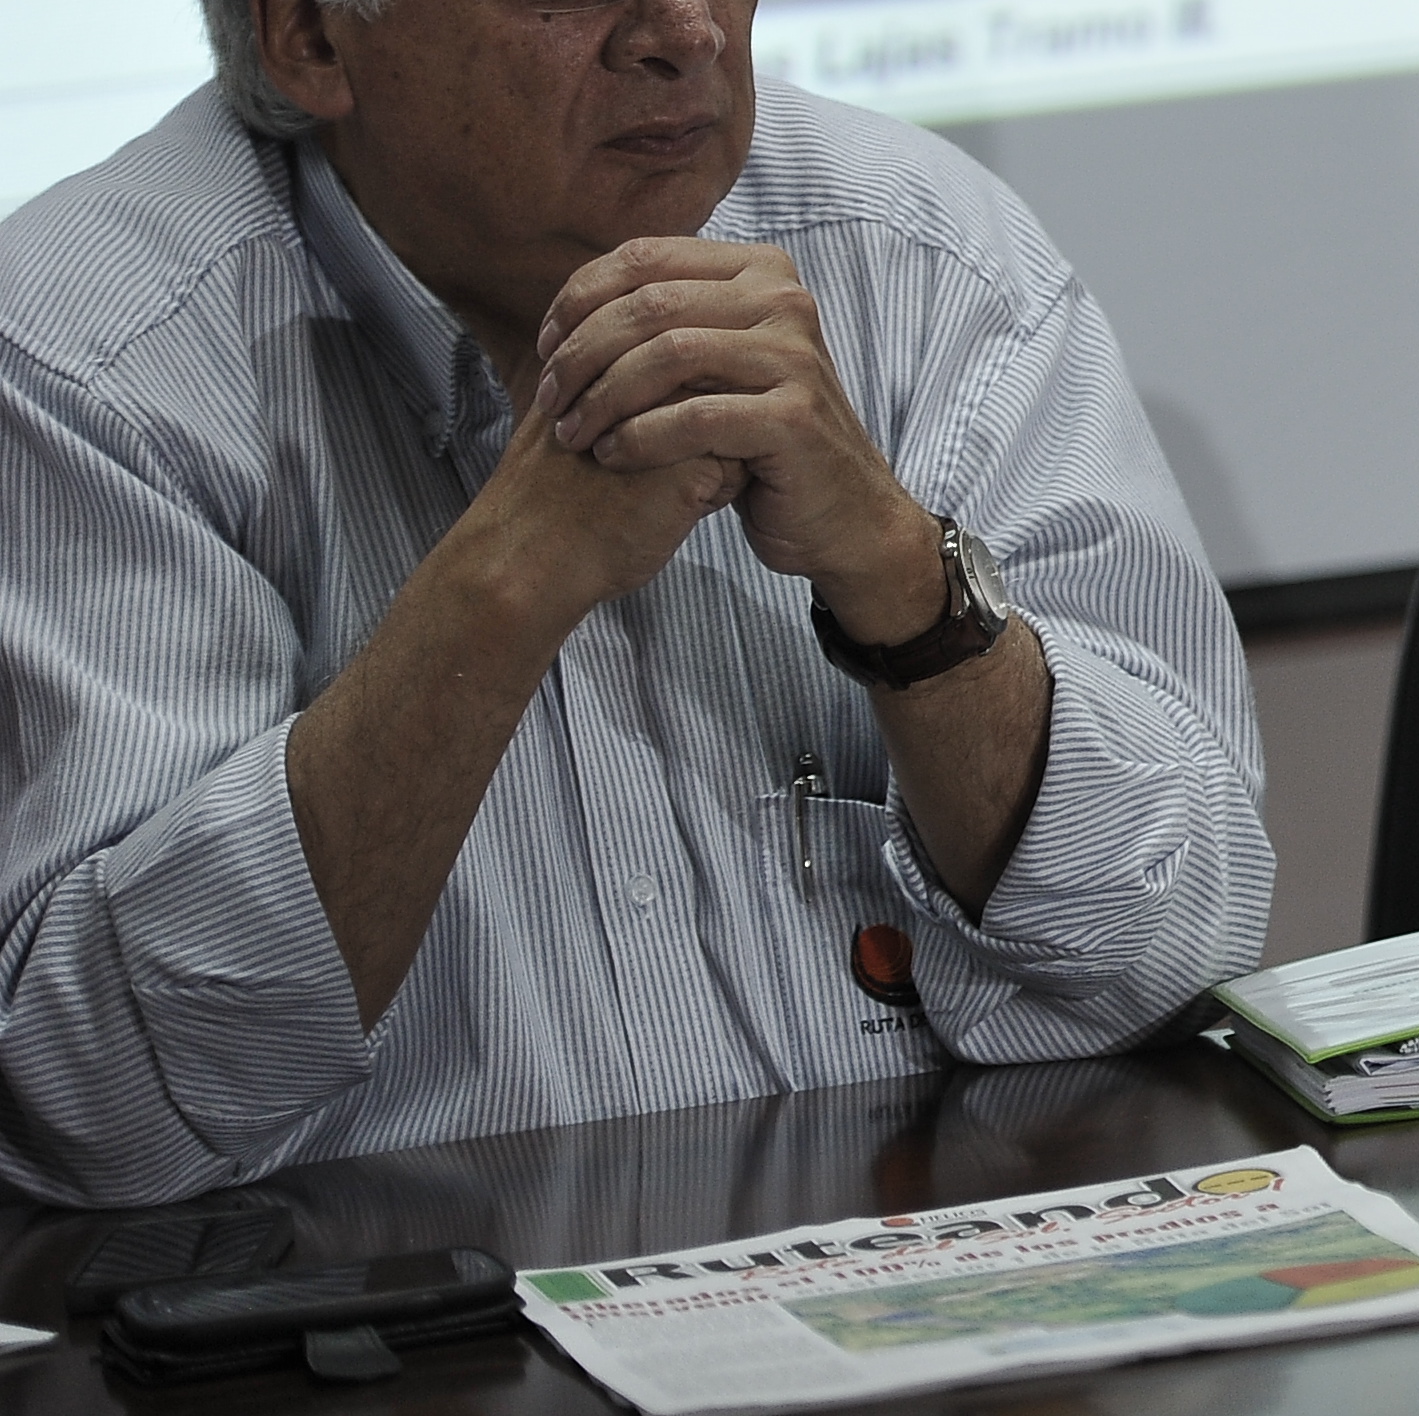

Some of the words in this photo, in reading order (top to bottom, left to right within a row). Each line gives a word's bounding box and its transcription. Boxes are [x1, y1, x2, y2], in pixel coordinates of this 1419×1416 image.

[860, 1017, 905, 1036] RUTA
[600, 1168, 1283, 1289] Ruteando
[1096, 1190, 1254, 1225] Sector
[829, 1258, 943, 1280] 100%
[953, 1251, 1004, 1263] de
[1013, 1238, 1079, 1253] los
[1092, 1209, 1243, 1243] predios
[1254, 1202, 1280, 1213] a
